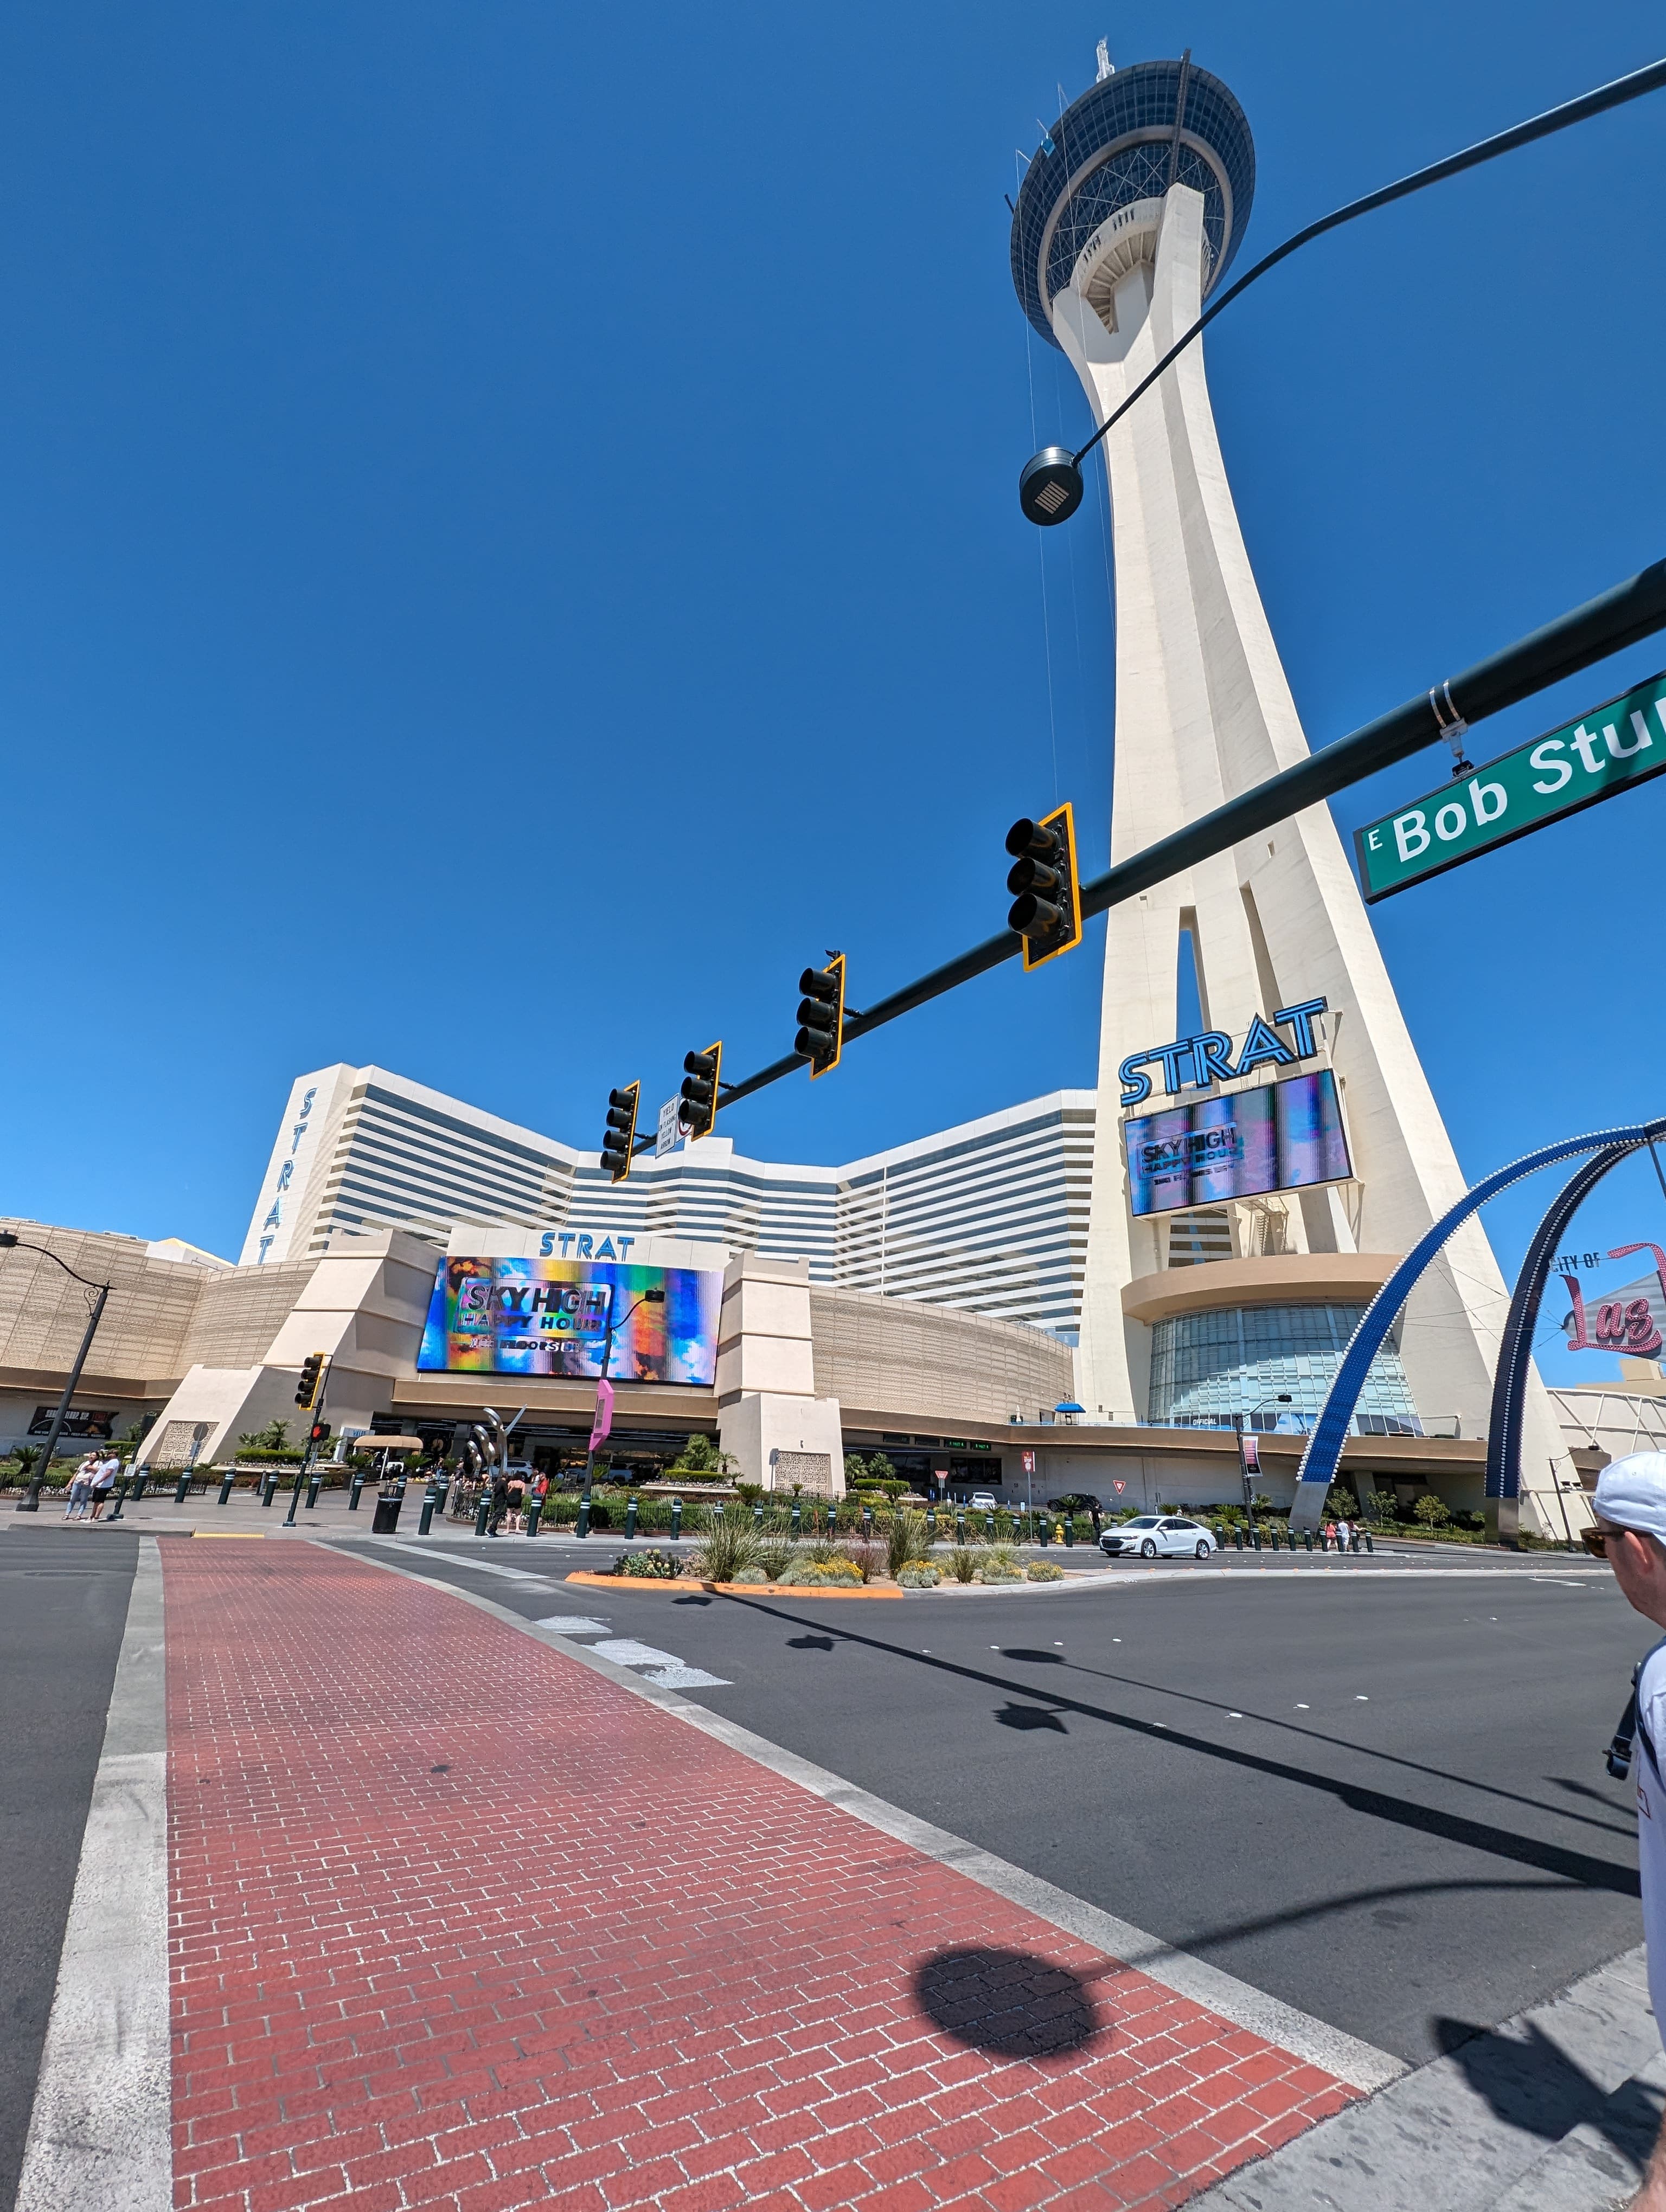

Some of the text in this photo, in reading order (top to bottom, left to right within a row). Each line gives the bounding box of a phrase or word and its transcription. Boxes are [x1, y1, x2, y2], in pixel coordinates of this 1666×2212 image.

[1368, 829, 1383, 851] E
[1393, 778, 1508, 863] Bob
[1118, 996, 1329, 1108] STRAT
[663, 1103, 675, 1117] YIELD
[661, 1138, 671, 1150] ARROW
[1142, 1127, 1236, 1163] SKY HIGH
[258, 1086, 319, 1265] STRAT
[540, 1232, 635, 1262] STRAT
[1550, 1252, 1600, 1272] CITY OF
[467, 1285, 606, 1316] SKY HIGH
[1559, 1274, 1662, 1354] Las
[462, 1314, 602, 1333] HAPPY HOUR
